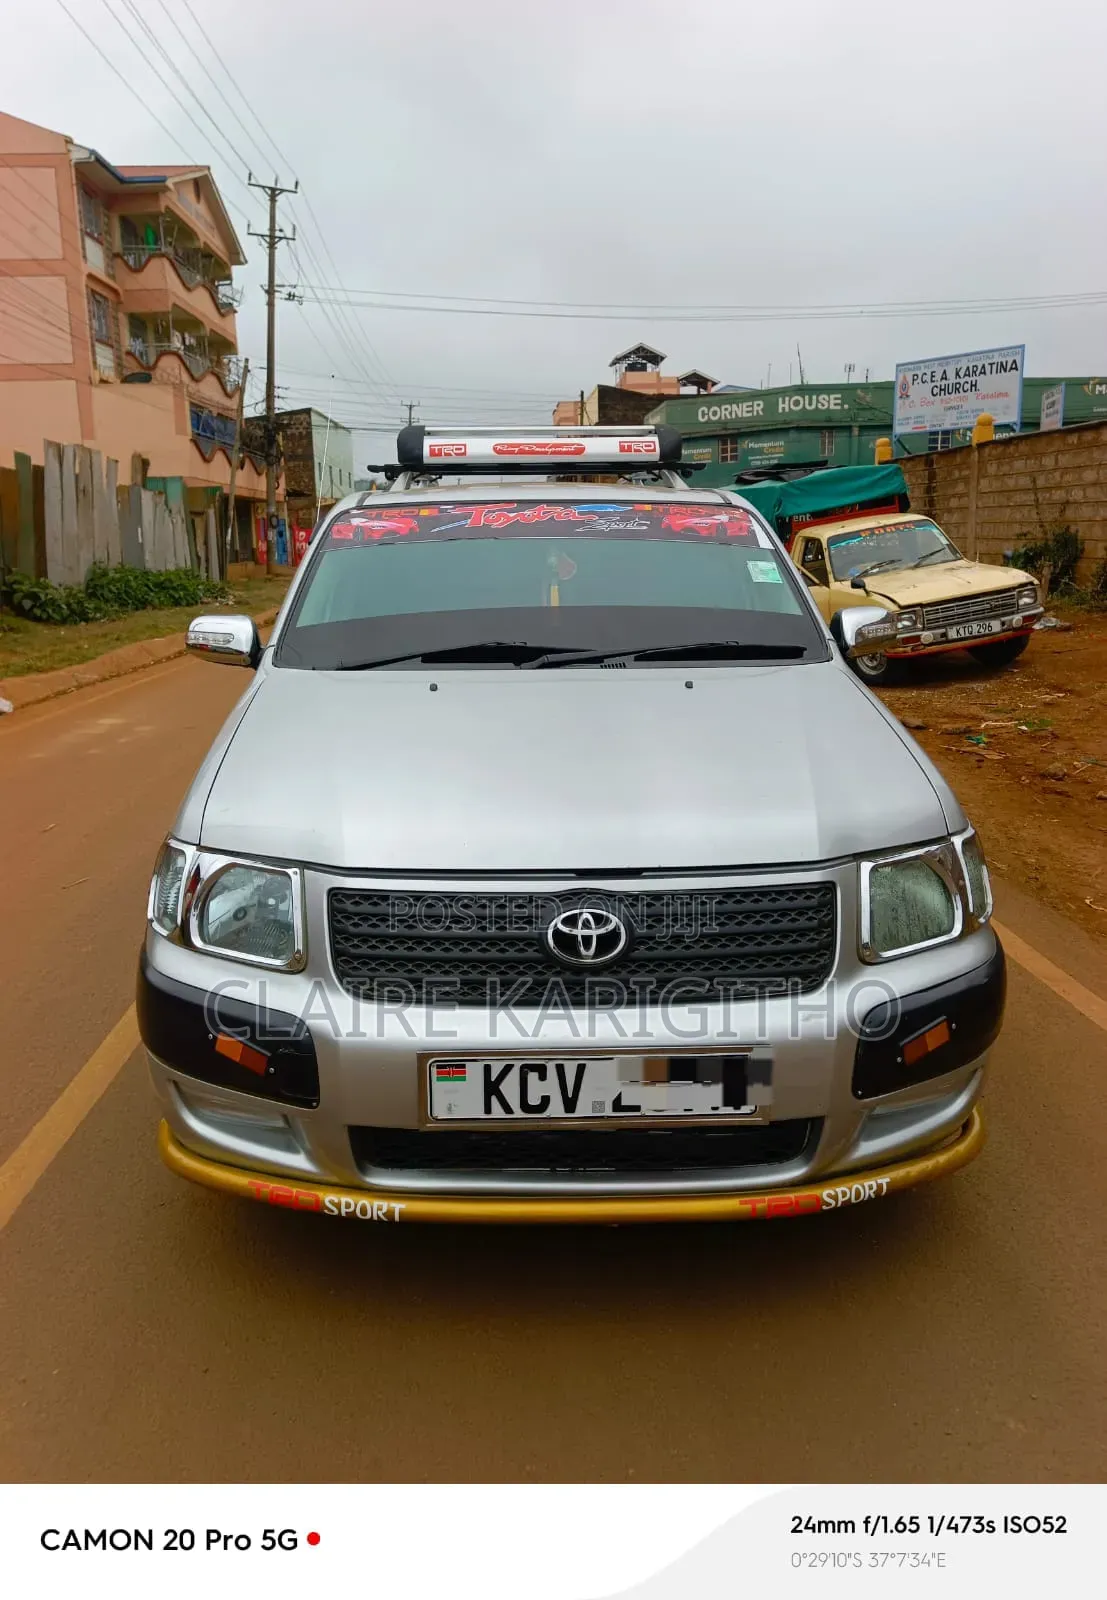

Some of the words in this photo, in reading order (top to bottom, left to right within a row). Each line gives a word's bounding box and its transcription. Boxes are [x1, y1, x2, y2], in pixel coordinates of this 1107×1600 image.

[912, 368, 950, 385] P.C.E.A.
[954, 359, 1019, 380] KARATINA
[930, 380, 980, 397] CHURCH.
[698, 400, 764, 422] CORNER
[778, 394, 849, 413] HOUSE.
[748, 440, 785, 448] Momentum
[977, 622, 993, 634] 296
[483, 1062, 587, 1115] KCV
[323, 1193, 407, 1222] SPORT
[821, 1177, 891, 1211] SPORT
